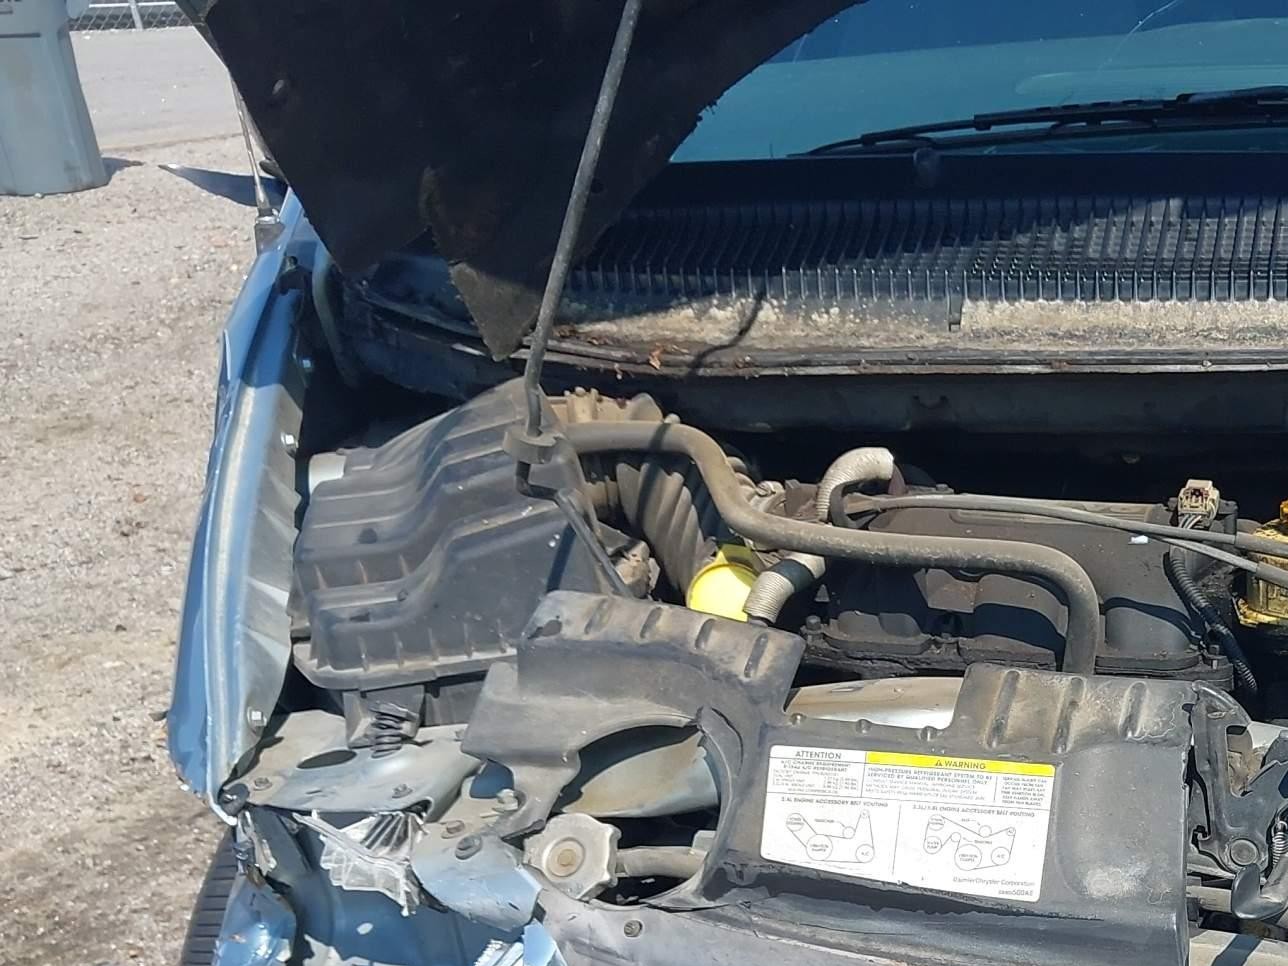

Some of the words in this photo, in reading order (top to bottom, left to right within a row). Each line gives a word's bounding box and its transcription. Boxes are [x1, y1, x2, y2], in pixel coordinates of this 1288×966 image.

[795, 750, 842, 760] ATTENTION
[944, 759, 987, 770] WARNING
[815, 798, 849, 806] ACCESSORY
